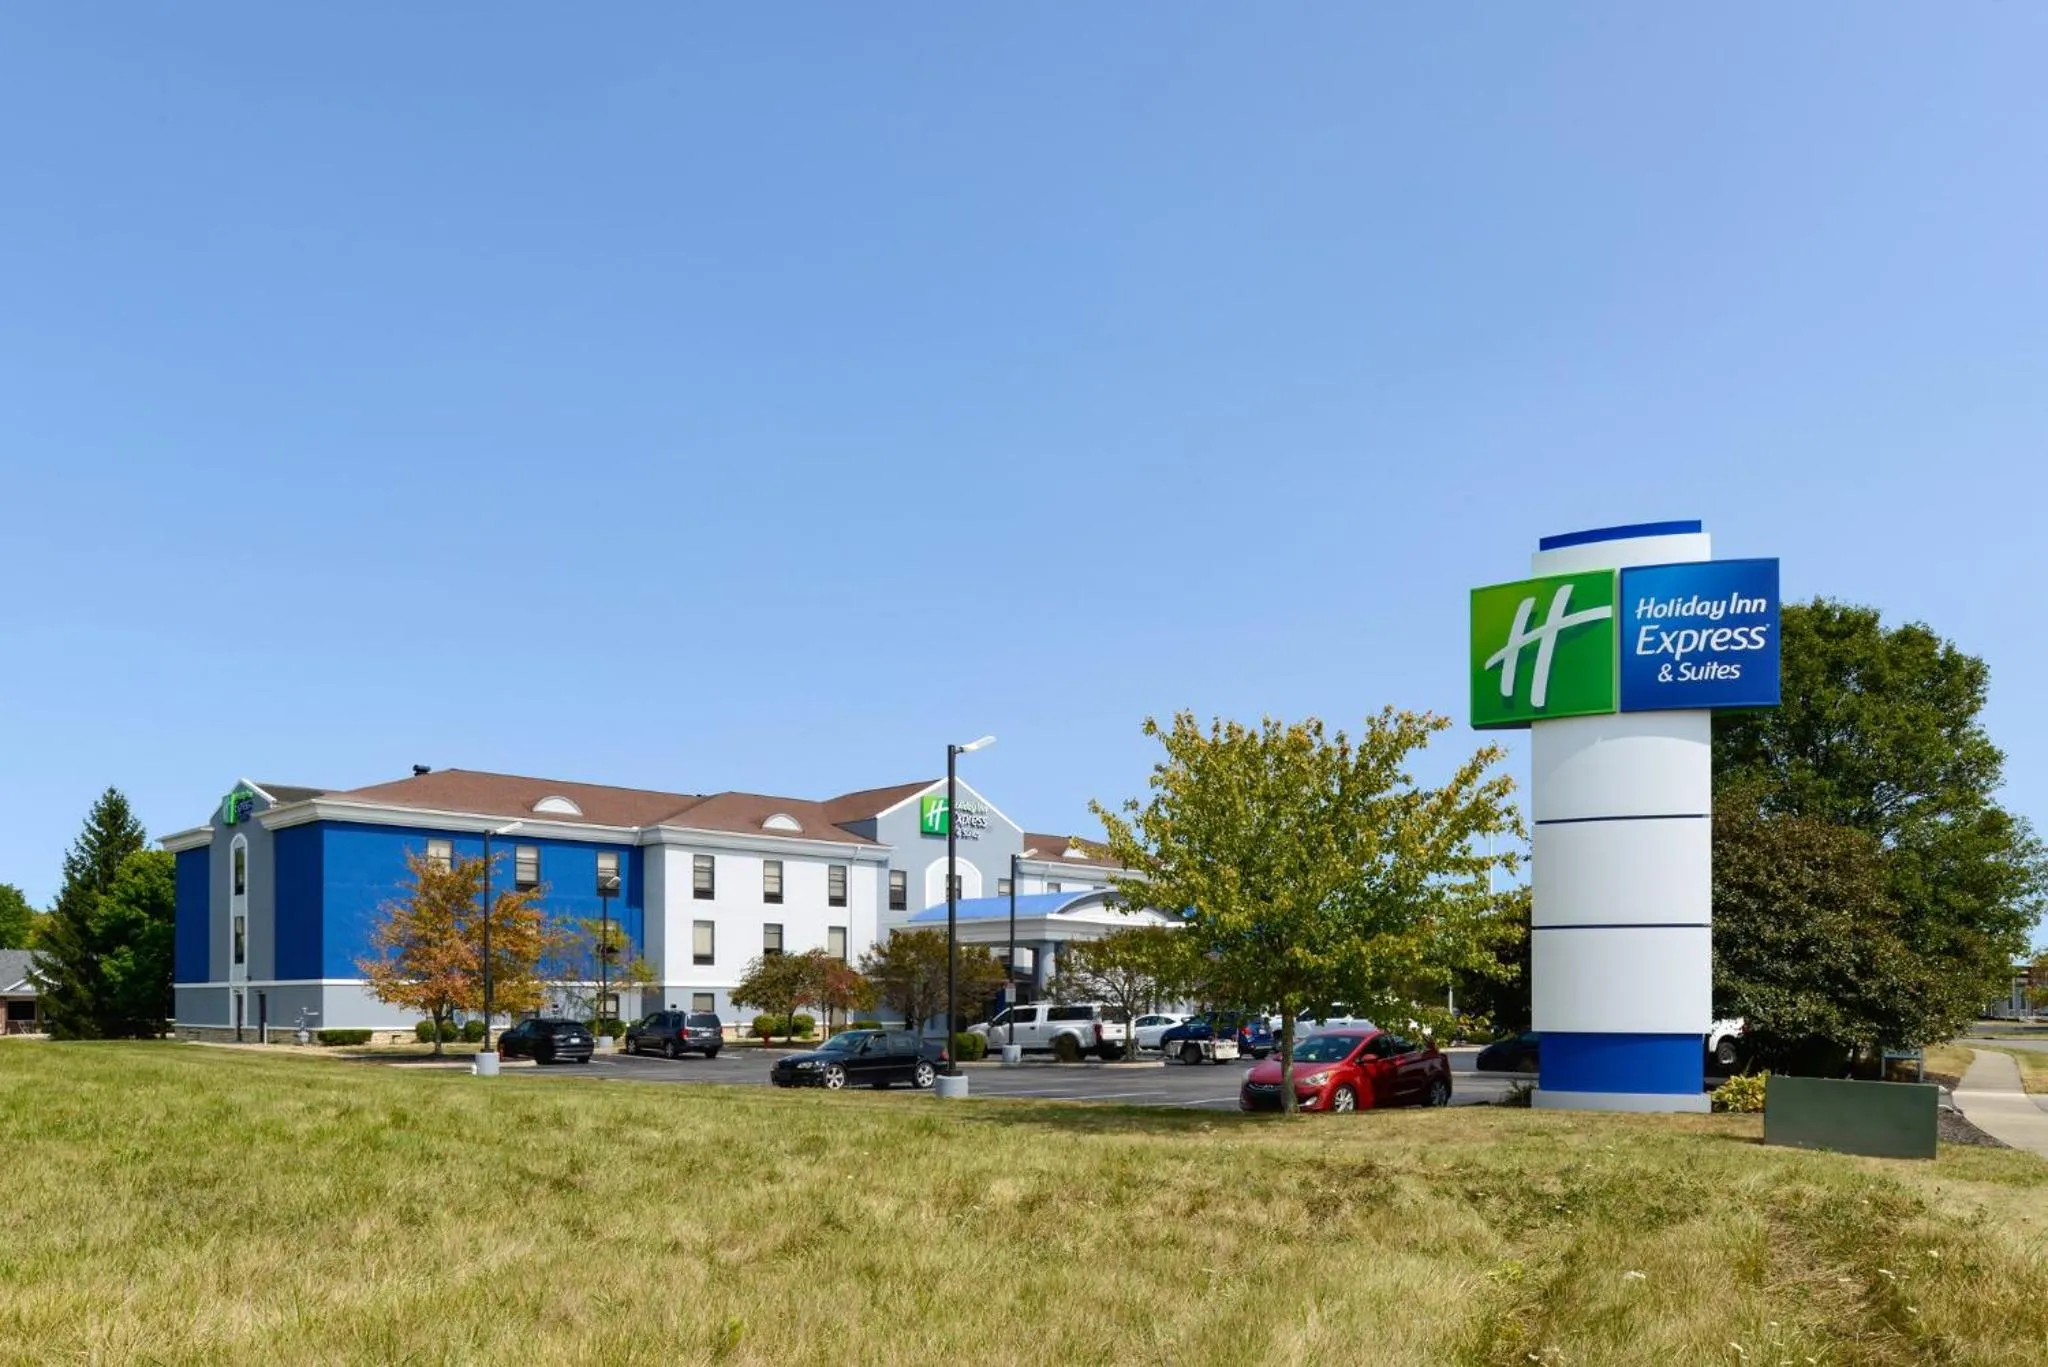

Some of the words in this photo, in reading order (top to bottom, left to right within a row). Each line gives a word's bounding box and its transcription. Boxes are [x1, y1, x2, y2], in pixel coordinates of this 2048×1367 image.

[1635, 594, 1726, 620] Holiday
[1729, 592, 1767, 614] Inn
[1485, 584, 1612, 707] H
[1636, 624, 1767, 661] Express
[1658, 663, 1673, 682] &
[1677, 661, 1741, 681] Suites
